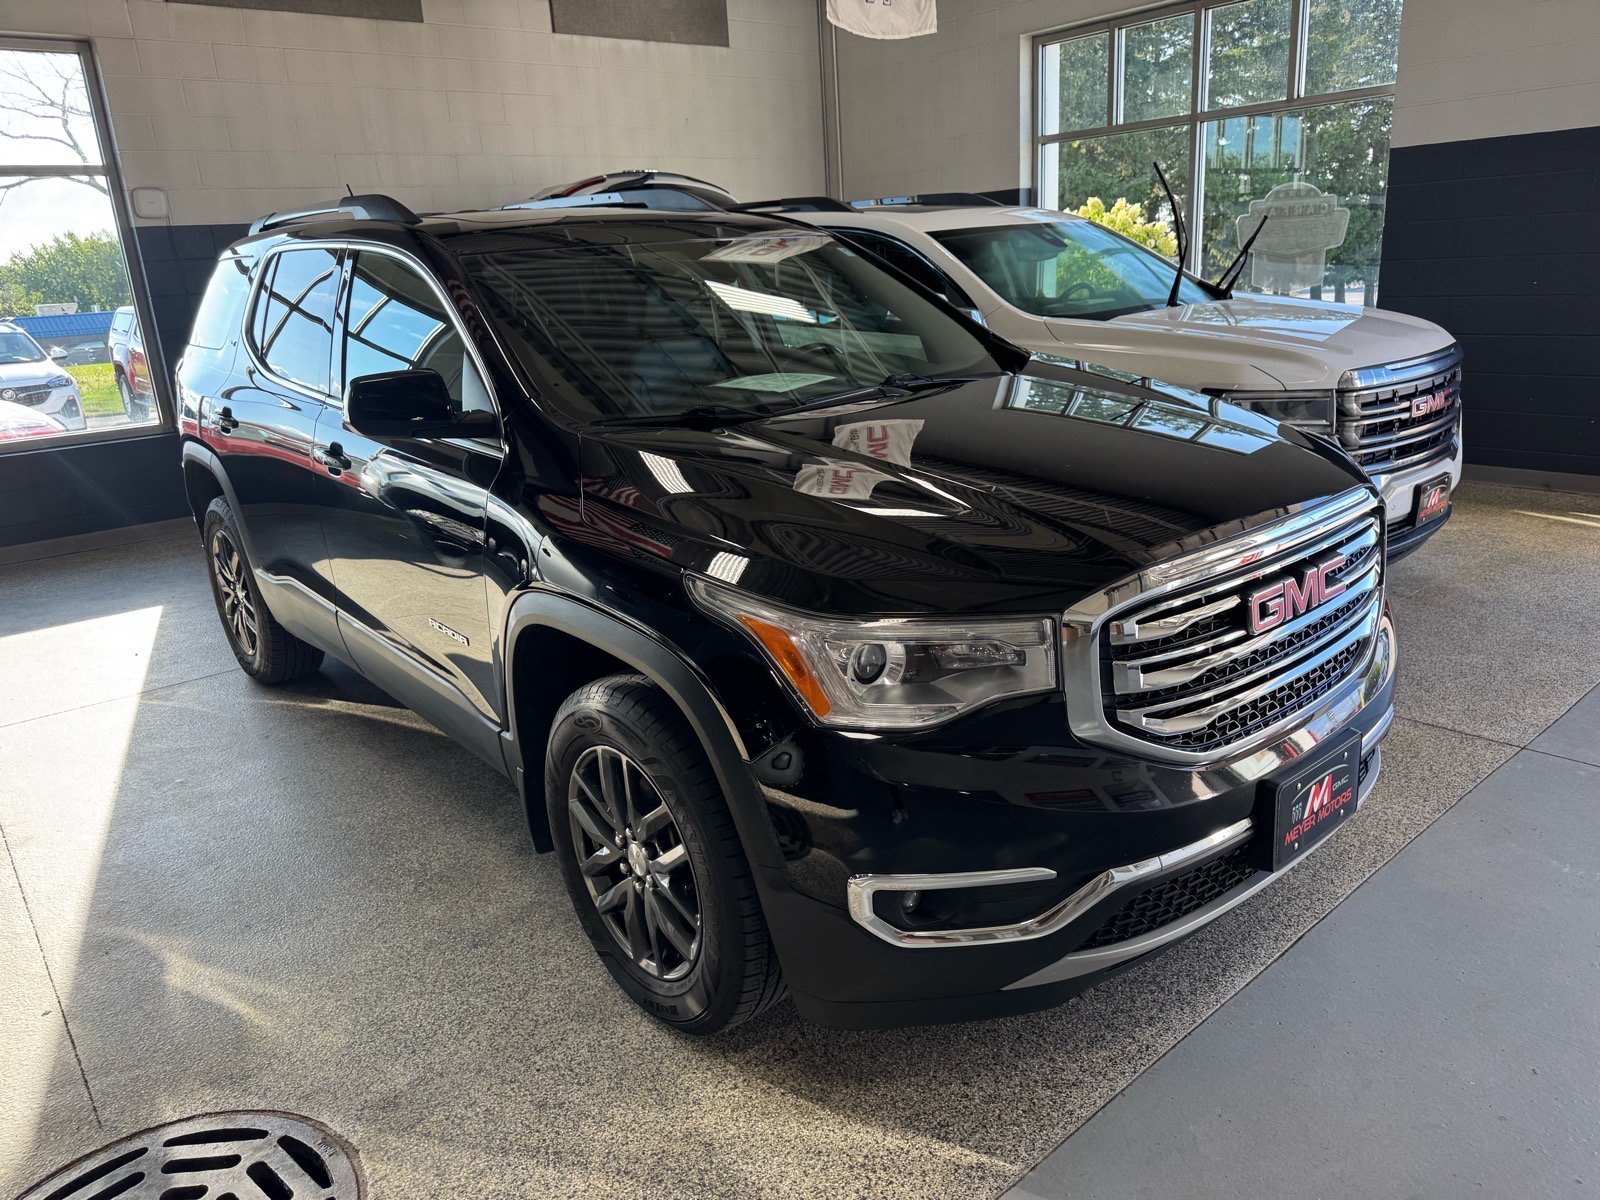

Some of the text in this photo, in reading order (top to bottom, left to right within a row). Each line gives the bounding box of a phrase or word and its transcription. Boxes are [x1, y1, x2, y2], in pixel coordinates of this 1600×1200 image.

[1411, 388, 1452, 417] GMC
[1250, 555, 1346, 634] GMC
[429, 618, 468, 646] ACADIA
[1303, 773, 1333, 820] M
[1332, 775, 1349, 791] GMC
[1285, 788, 1352, 846] MEYER MOTORS
